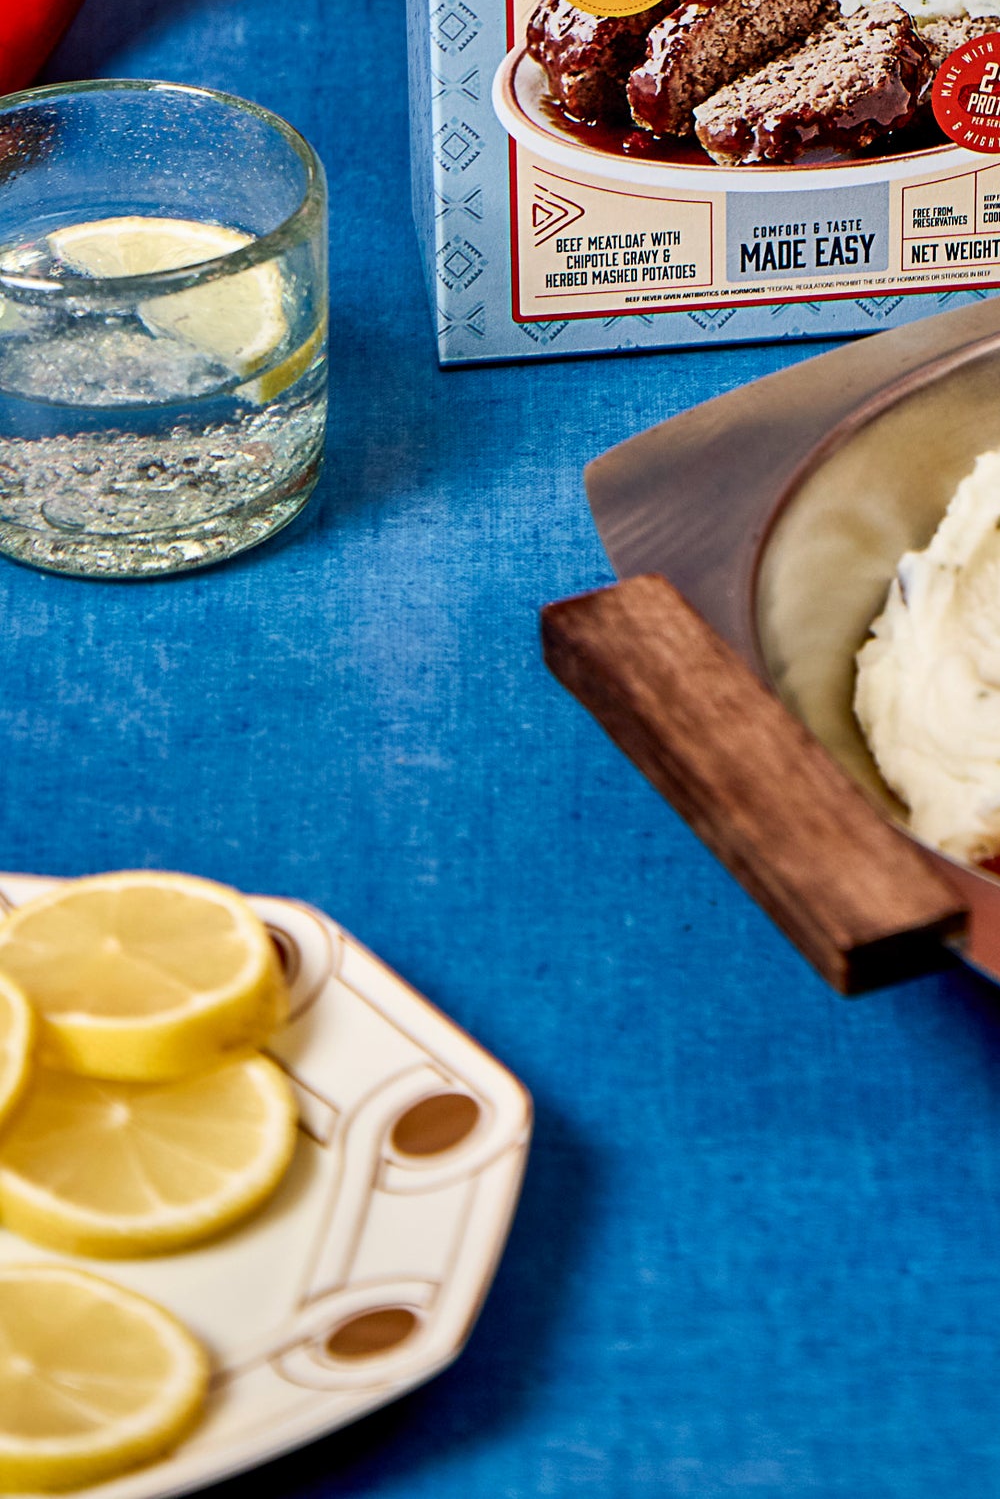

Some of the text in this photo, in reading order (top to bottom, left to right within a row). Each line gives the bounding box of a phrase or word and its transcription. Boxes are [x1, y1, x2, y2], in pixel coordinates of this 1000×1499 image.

[941, 66, 962, 97] MADE
[961, 42, 993, 64] WITH
[971, 116, 984, 126] PER
[912, 206, 953, 219] FREE FROM
[912, 215, 968, 229] PRESERVATIVES
[753, 218, 863, 239] COMFORT & TASTE
[556, 231, 681, 253] BEEF MEATLOAF WITH
[566, 248, 671, 270] CHIPOTLE GRAVY &
[740, 233, 876, 273] MADE EASY
[911, 243, 940, 264] NET
[545, 264, 697, 289] HERBED MASHED POTATOES
